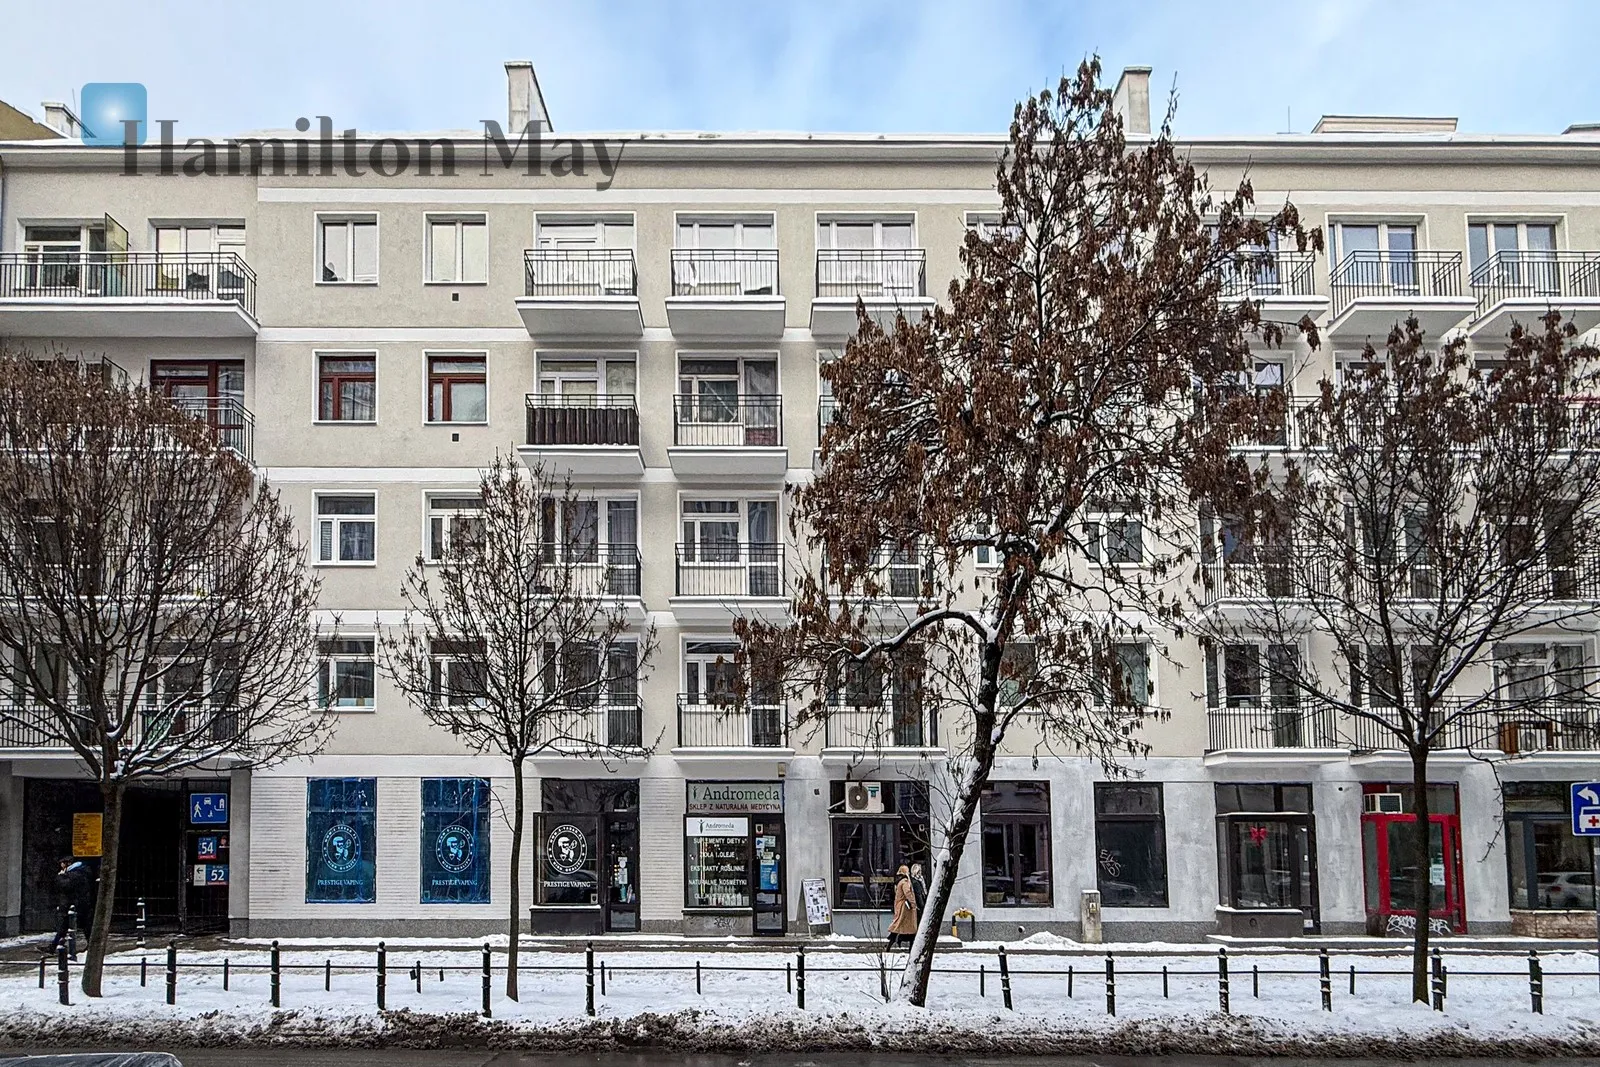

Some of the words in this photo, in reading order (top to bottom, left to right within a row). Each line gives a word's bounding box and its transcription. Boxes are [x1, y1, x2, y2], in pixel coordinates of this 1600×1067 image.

[702, 785, 780, 801] Andromeda
[689, 803, 706, 811] SKLEP
[715, 803, 749, 812] NATURALNĄ
[750, 803, 781, 812] MEDYCYNĄ
[201, 842, 214, 854] 54
[211, 869, 225, 881] 52
